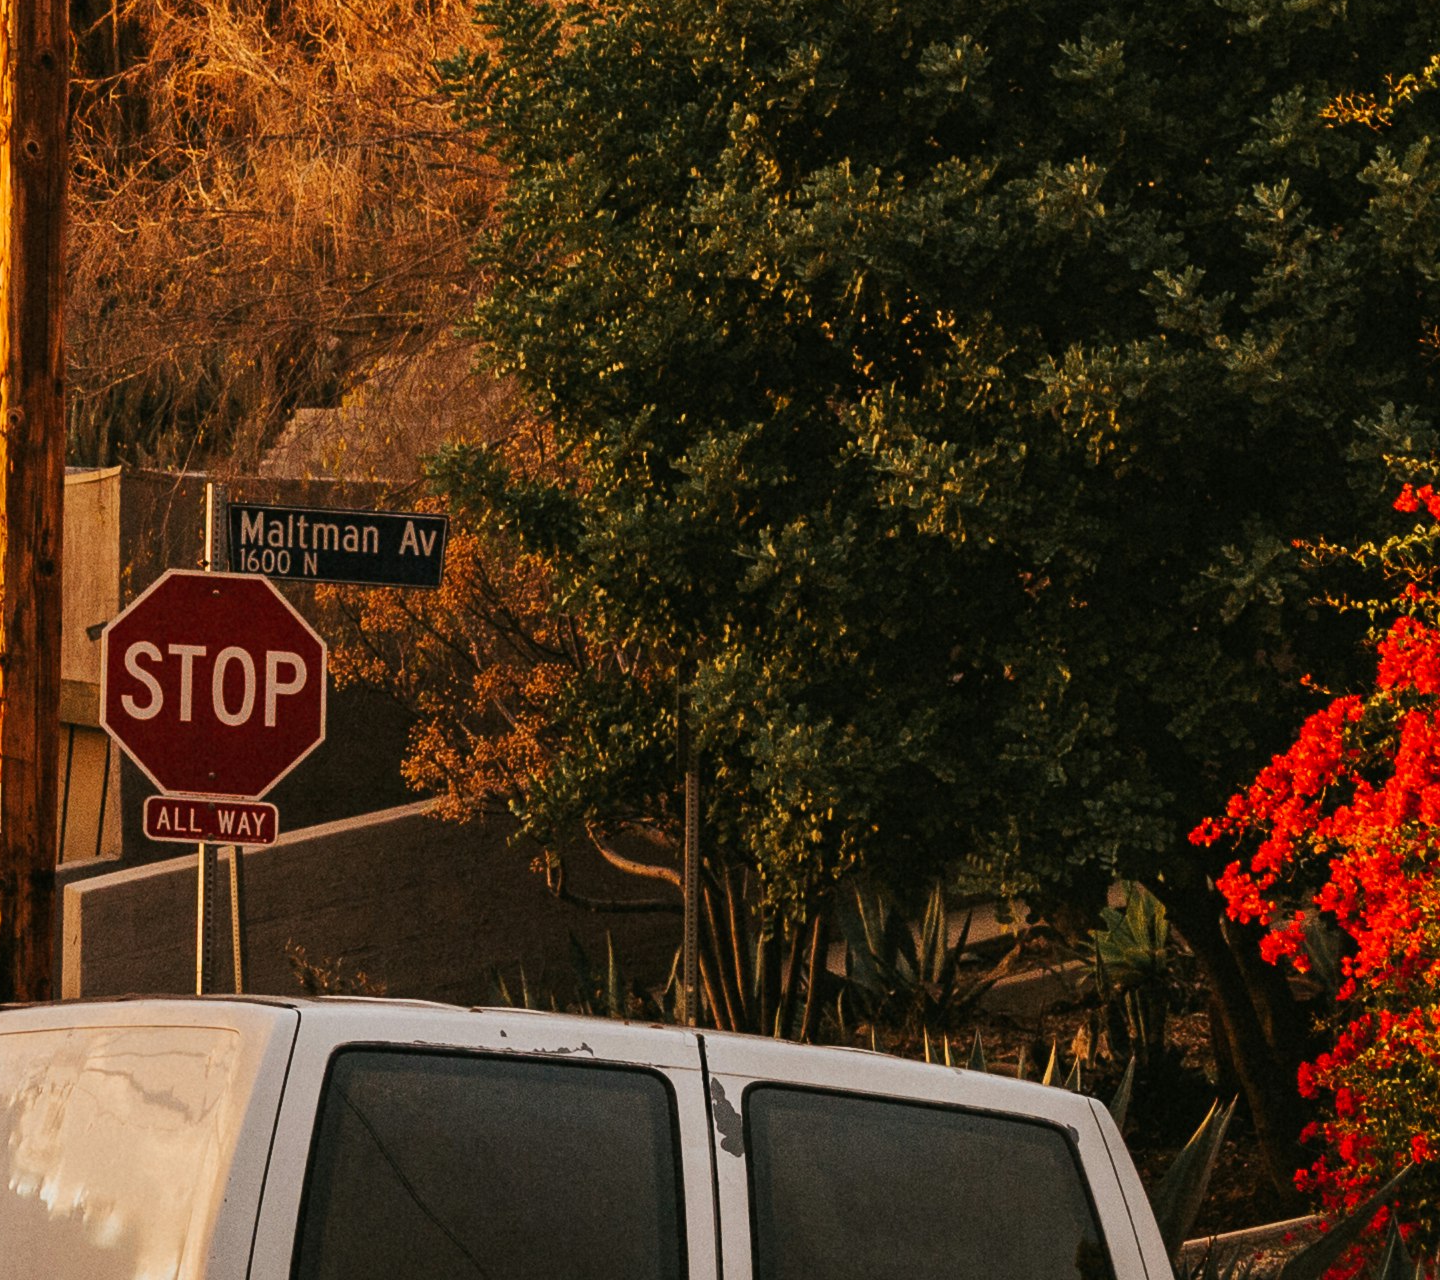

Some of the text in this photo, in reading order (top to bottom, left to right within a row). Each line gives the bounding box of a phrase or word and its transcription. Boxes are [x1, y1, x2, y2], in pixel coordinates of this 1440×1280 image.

[240, 510, 437, 557] Maltman Av
[240, 548, 318, 576] 1600 N
[121, 641, 308, 727] STOP
[155, 806, 266, 837] ALL WAY
